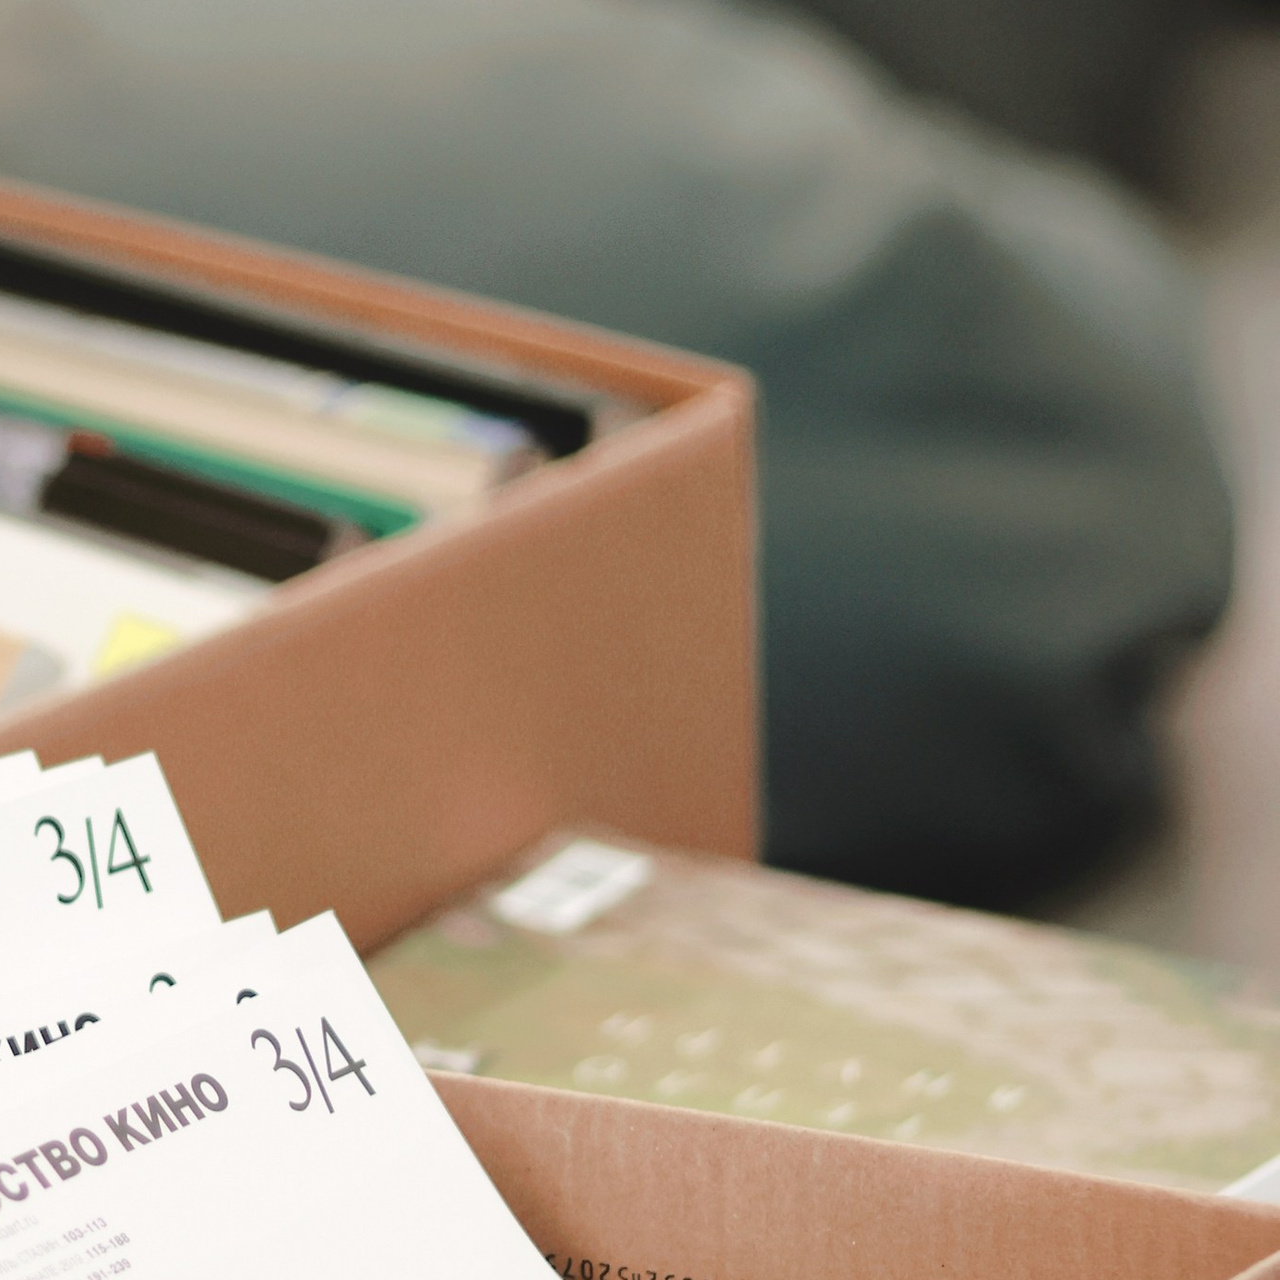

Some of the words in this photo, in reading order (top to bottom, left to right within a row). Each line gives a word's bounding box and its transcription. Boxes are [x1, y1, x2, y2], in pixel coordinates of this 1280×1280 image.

[34, 808, 153, 909] 3/4
[104, 1073, 228, 1152] КИНО
[251, 1017, 376, 1114] 3/4
